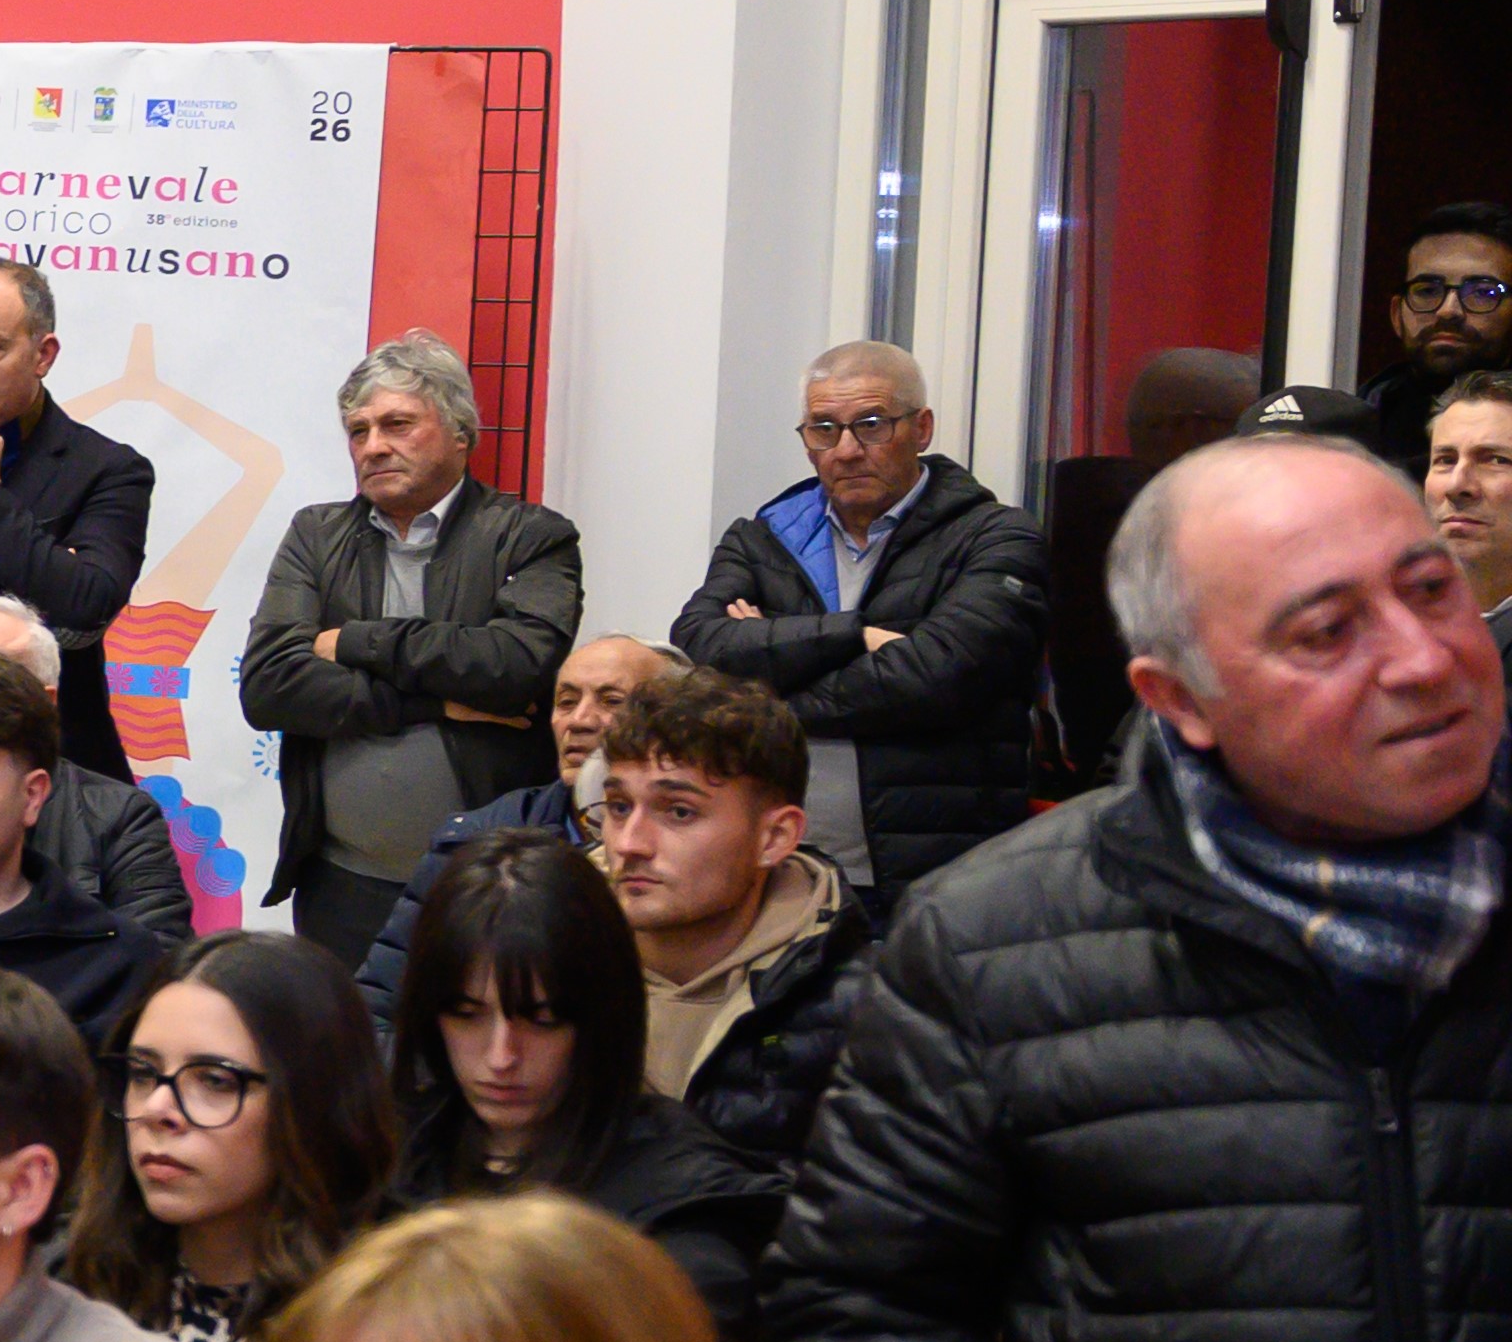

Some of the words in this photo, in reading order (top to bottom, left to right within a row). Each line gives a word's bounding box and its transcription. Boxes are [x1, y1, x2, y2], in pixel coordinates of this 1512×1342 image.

[177, 99, 238, 110] MINISTERO
[311, 90, 353, 115] 20
[176, 109, 205, 118] DELLA
[176, 119, 236, 130] CULTURA
[310, 117, 352, 143] 26
[173, 215, 238, 229] edizione
[1258, 411, 1304, 423] adidas
